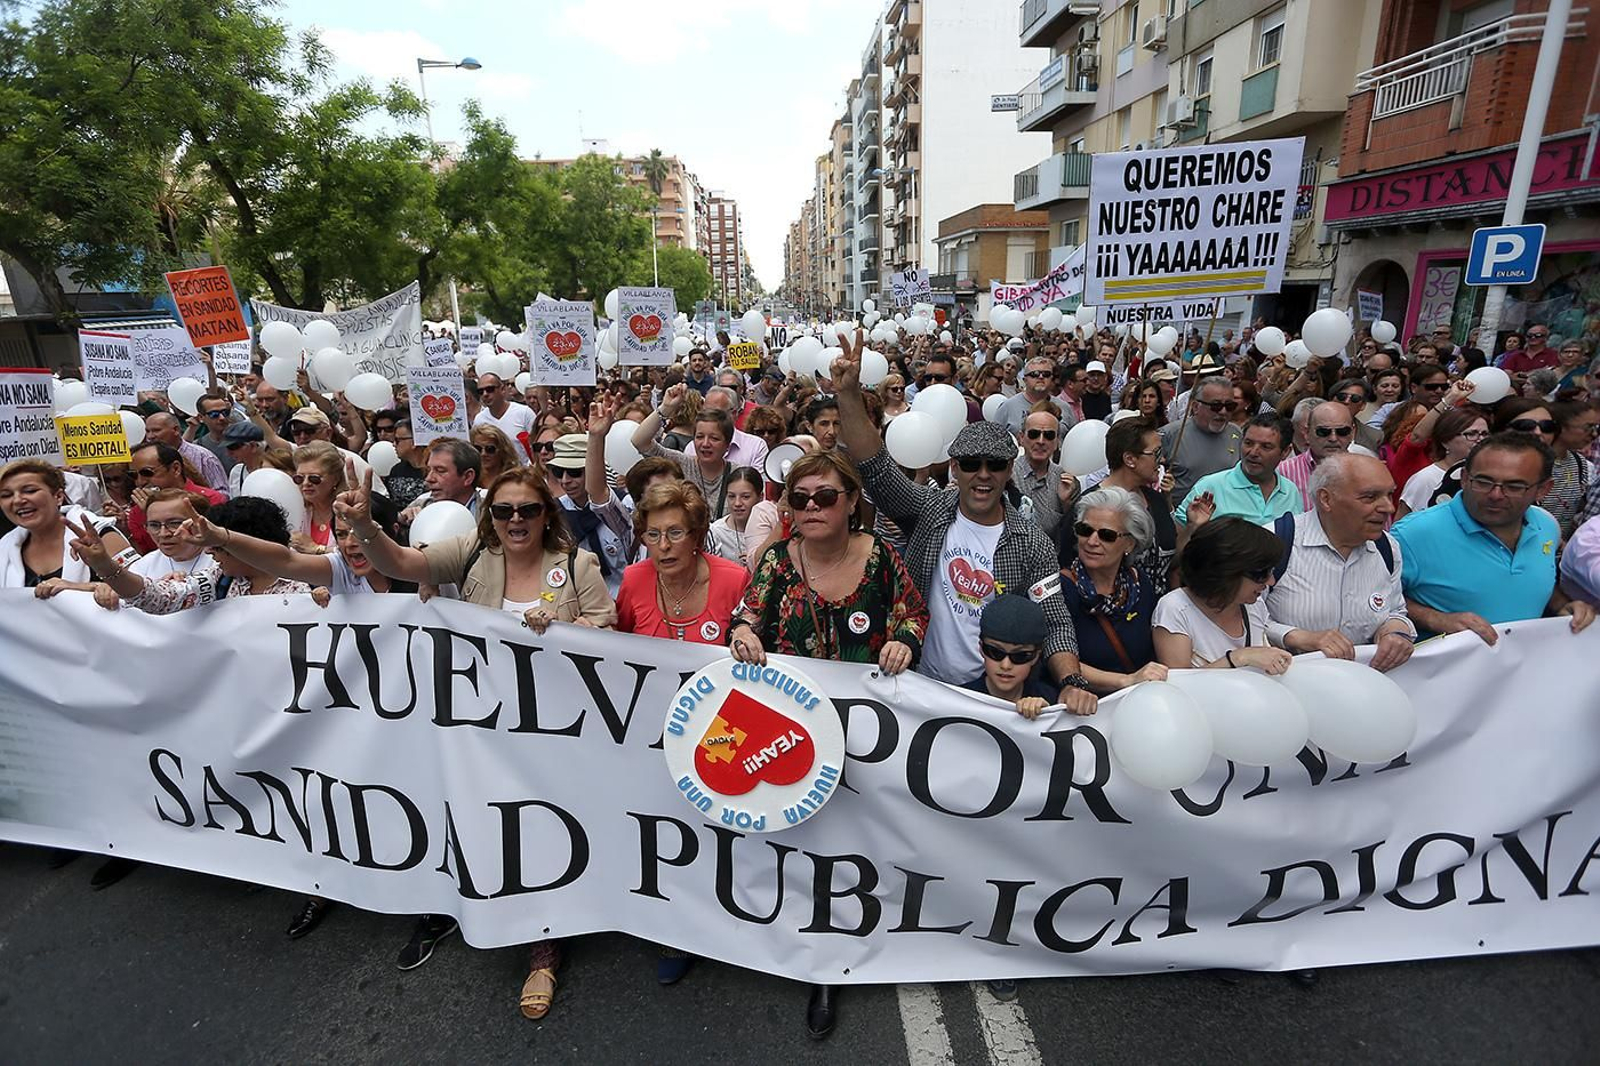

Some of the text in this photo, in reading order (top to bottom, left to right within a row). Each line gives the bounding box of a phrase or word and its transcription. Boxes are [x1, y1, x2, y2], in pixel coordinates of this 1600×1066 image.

[1124, 148, 1272, 193] QUEREMOS
[1098, 189, 1286, 236] NUESTRO CHARE
[1480, 233, 1526, 278] P
[903, 270, 918, 282] NO
[1425, 268, 1458, 298] 3€
[1496, 270, 1505, 278] EN
[171, 275, 229, 296] RECORTES
[179, 296, 236, 319] EN SANIDAD
[536, 303, 591, 313] VILLABLANCA
[1106, 305, 1174, 324] NUESTRA
[186, 318, 244, 339] MATAN.
[771, 327, 787, 348] NO
[84, 343, 105, 358] SUSANA
[105, 344, 114, 359] NO
[215, 351, 250, 360] Susana
[729, 345, 758, 359] ROBAN
[12, 384, 25, 405] NO
[111, 385, 120, 395] con
[14, 413, 55, 432] Andalucía
[62, 420, 123, 441] ¡Menos Sanidad
[26, 443, 41, 456] con
[66, 440, 128, 458] ES MORTAL!
[952, 566, 989, 598] Yeah!!
[277, 622, 695, 749] HUELV
[731, 662, 822, 711] SANIDAD
[667, 675, 716, 736] DIGNA
[741, 729, 805, 775] YEAH!!
[677, 775, 713, 813] UNA
[783, 764, 839, 824] HUELVA
[721, 807, 767, 831] POR
[148, 747, 590, 901] SANIDAD
[626, 811, 1199, 954] PUBLICA
